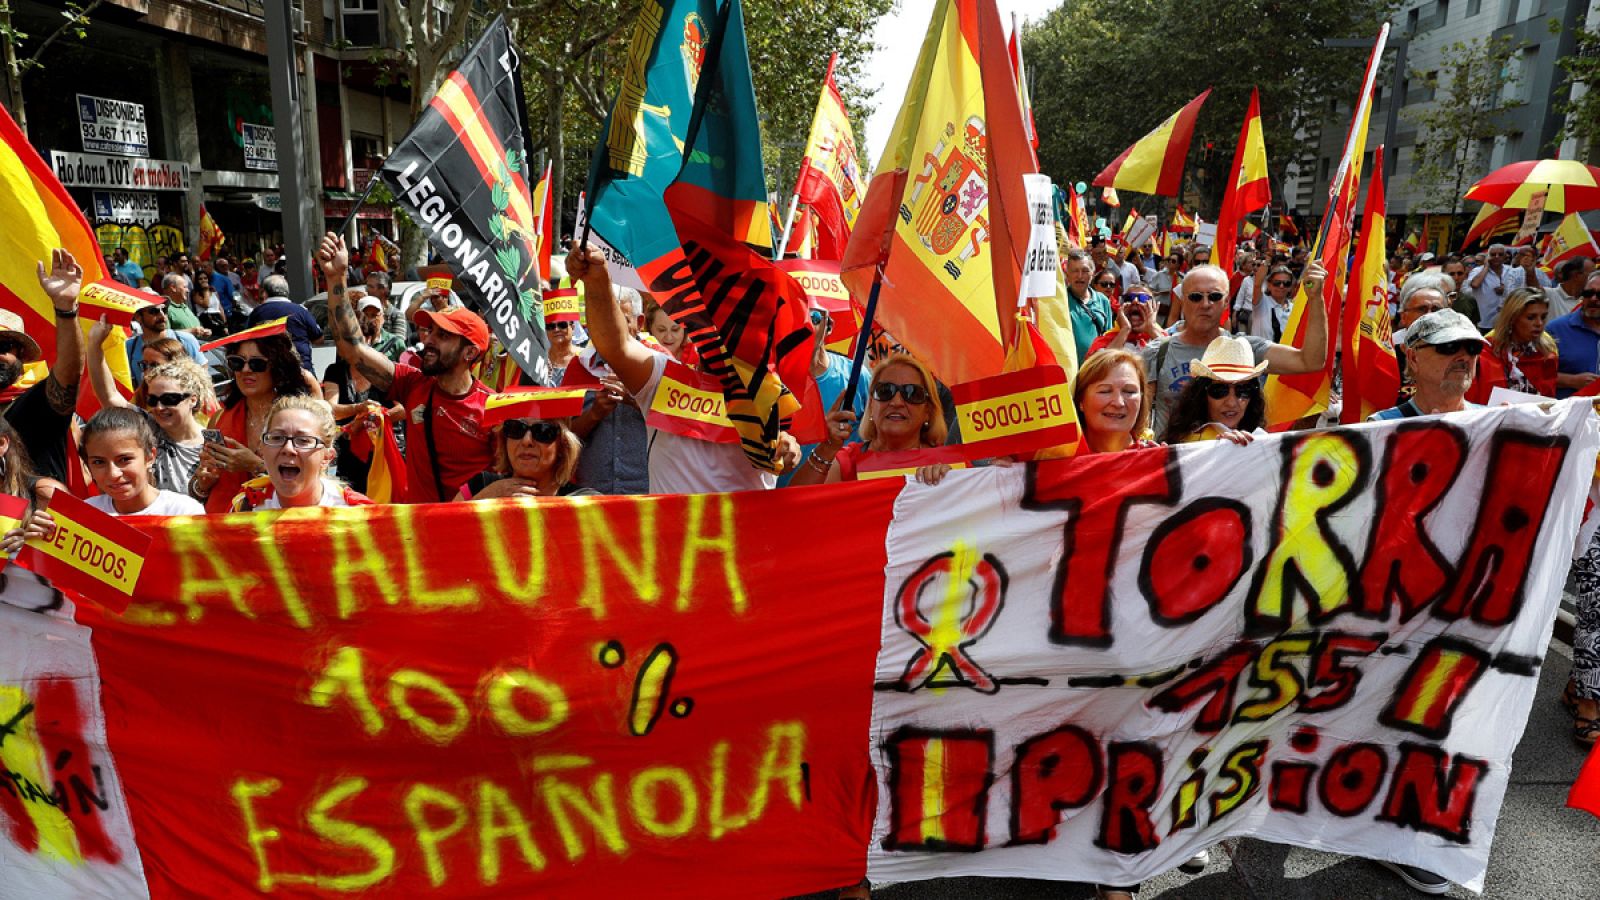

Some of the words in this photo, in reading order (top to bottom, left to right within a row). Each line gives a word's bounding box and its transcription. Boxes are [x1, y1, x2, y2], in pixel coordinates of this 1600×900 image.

[96, 99, 144, 123] DISPONIBLE
[82, 123, 97, 138] 93
[99, 126, 117, 140] 467
[120, 128, 133, 142] 11
[135, 130, 148, 144] 15
[254, 126, 276, 142] DISPON
[56, 155, 74, 184] Ho
[77, 157, 106, 185] dona
[106, 158, 130, 185] TOT
[132, 166, 146, 186] en
[147, 163, 181, 188] mobles
[111, 192, 157, 210] DISPONIBLE
[396, 160, 520, 340] LEGIONARIOS
[515, 337, 532, 364] A
[667, 387, 722, 417] TODOS.
[966, 401, 1034, 432] TODOS.
[1036, 394, 1063, 419] DE
[1020, 418, 1572, 650] TORRA
[42, 525, 69, 550] DE
[70, 533, 128, 583] TODOS.
[228, 719, 807, 893] ESPAÑOLA
